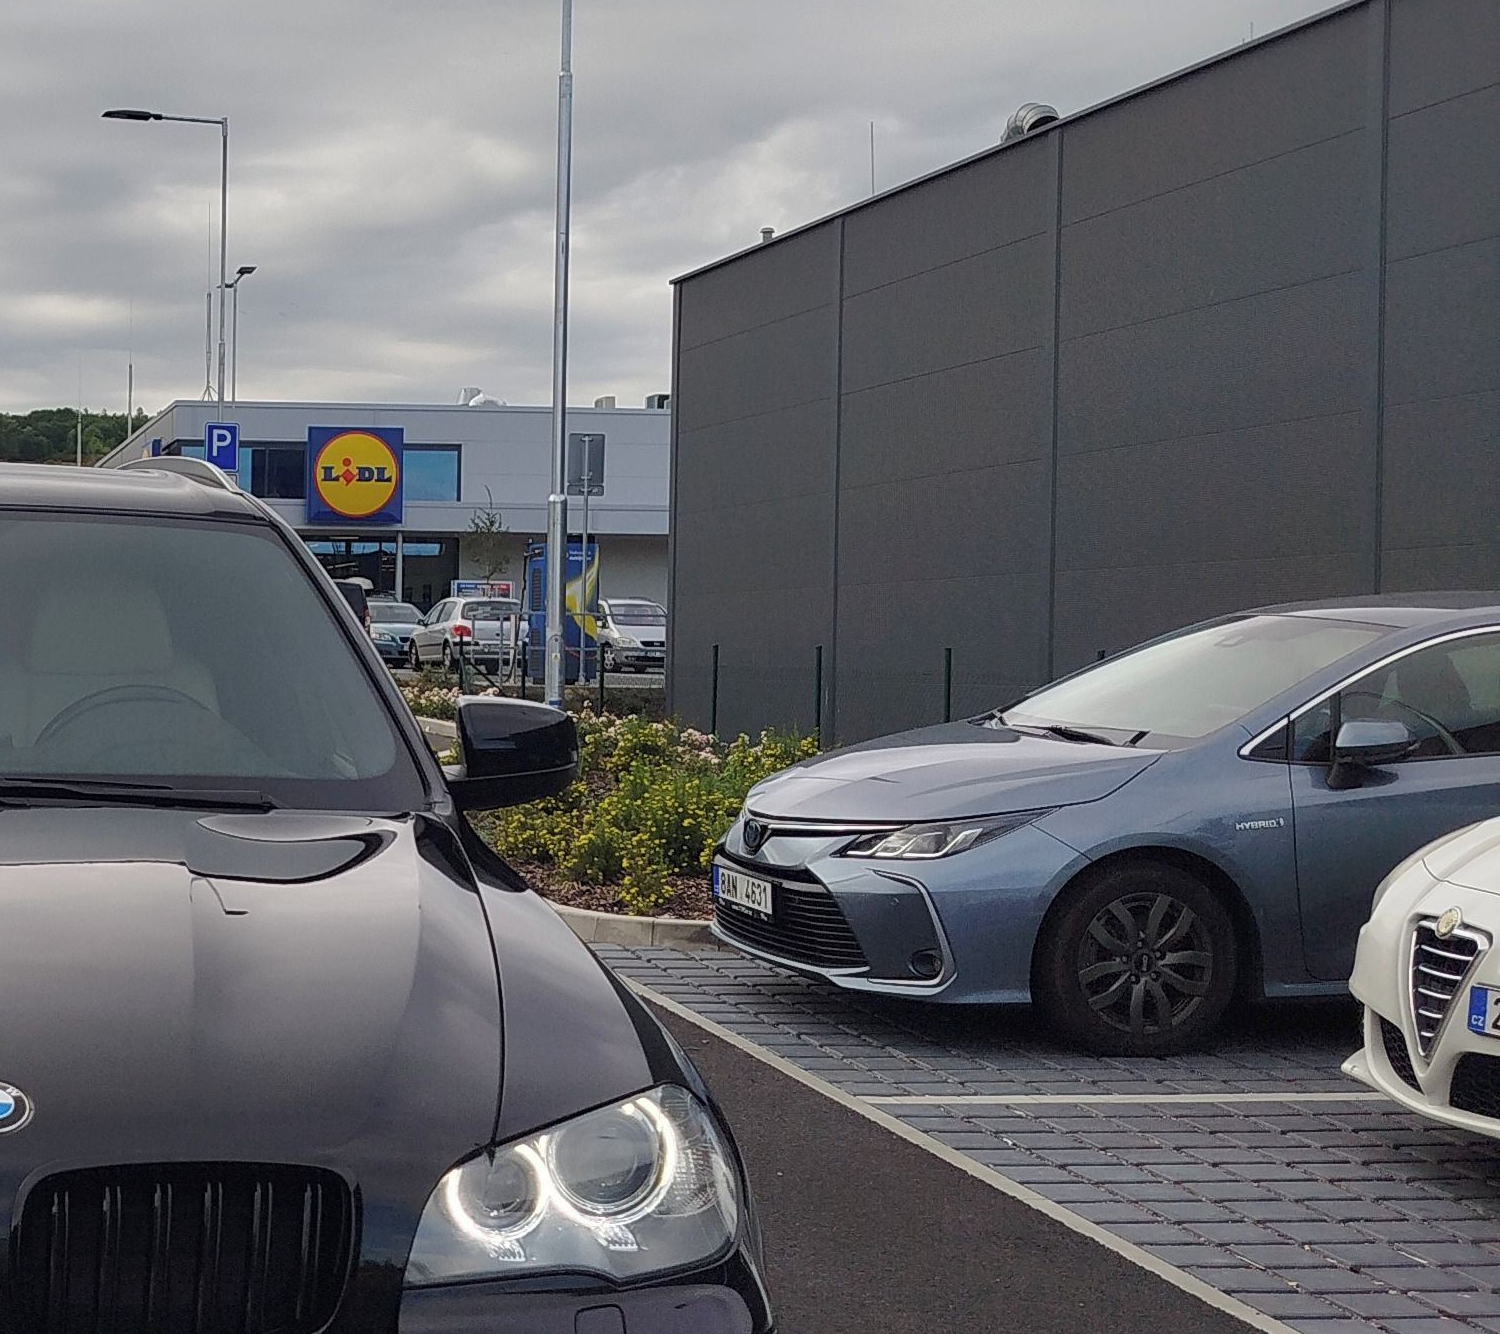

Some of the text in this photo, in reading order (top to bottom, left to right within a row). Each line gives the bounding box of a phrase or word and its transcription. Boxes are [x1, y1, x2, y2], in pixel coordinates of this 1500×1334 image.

[212, 429, 232, 457] P
[1235, 820, 1277, 831] HYBRID
[720, 871, 738, 899] 8AN
[745, 879, 768, 909] 4631
[1471, 1014, 1485, 1027] CZ
